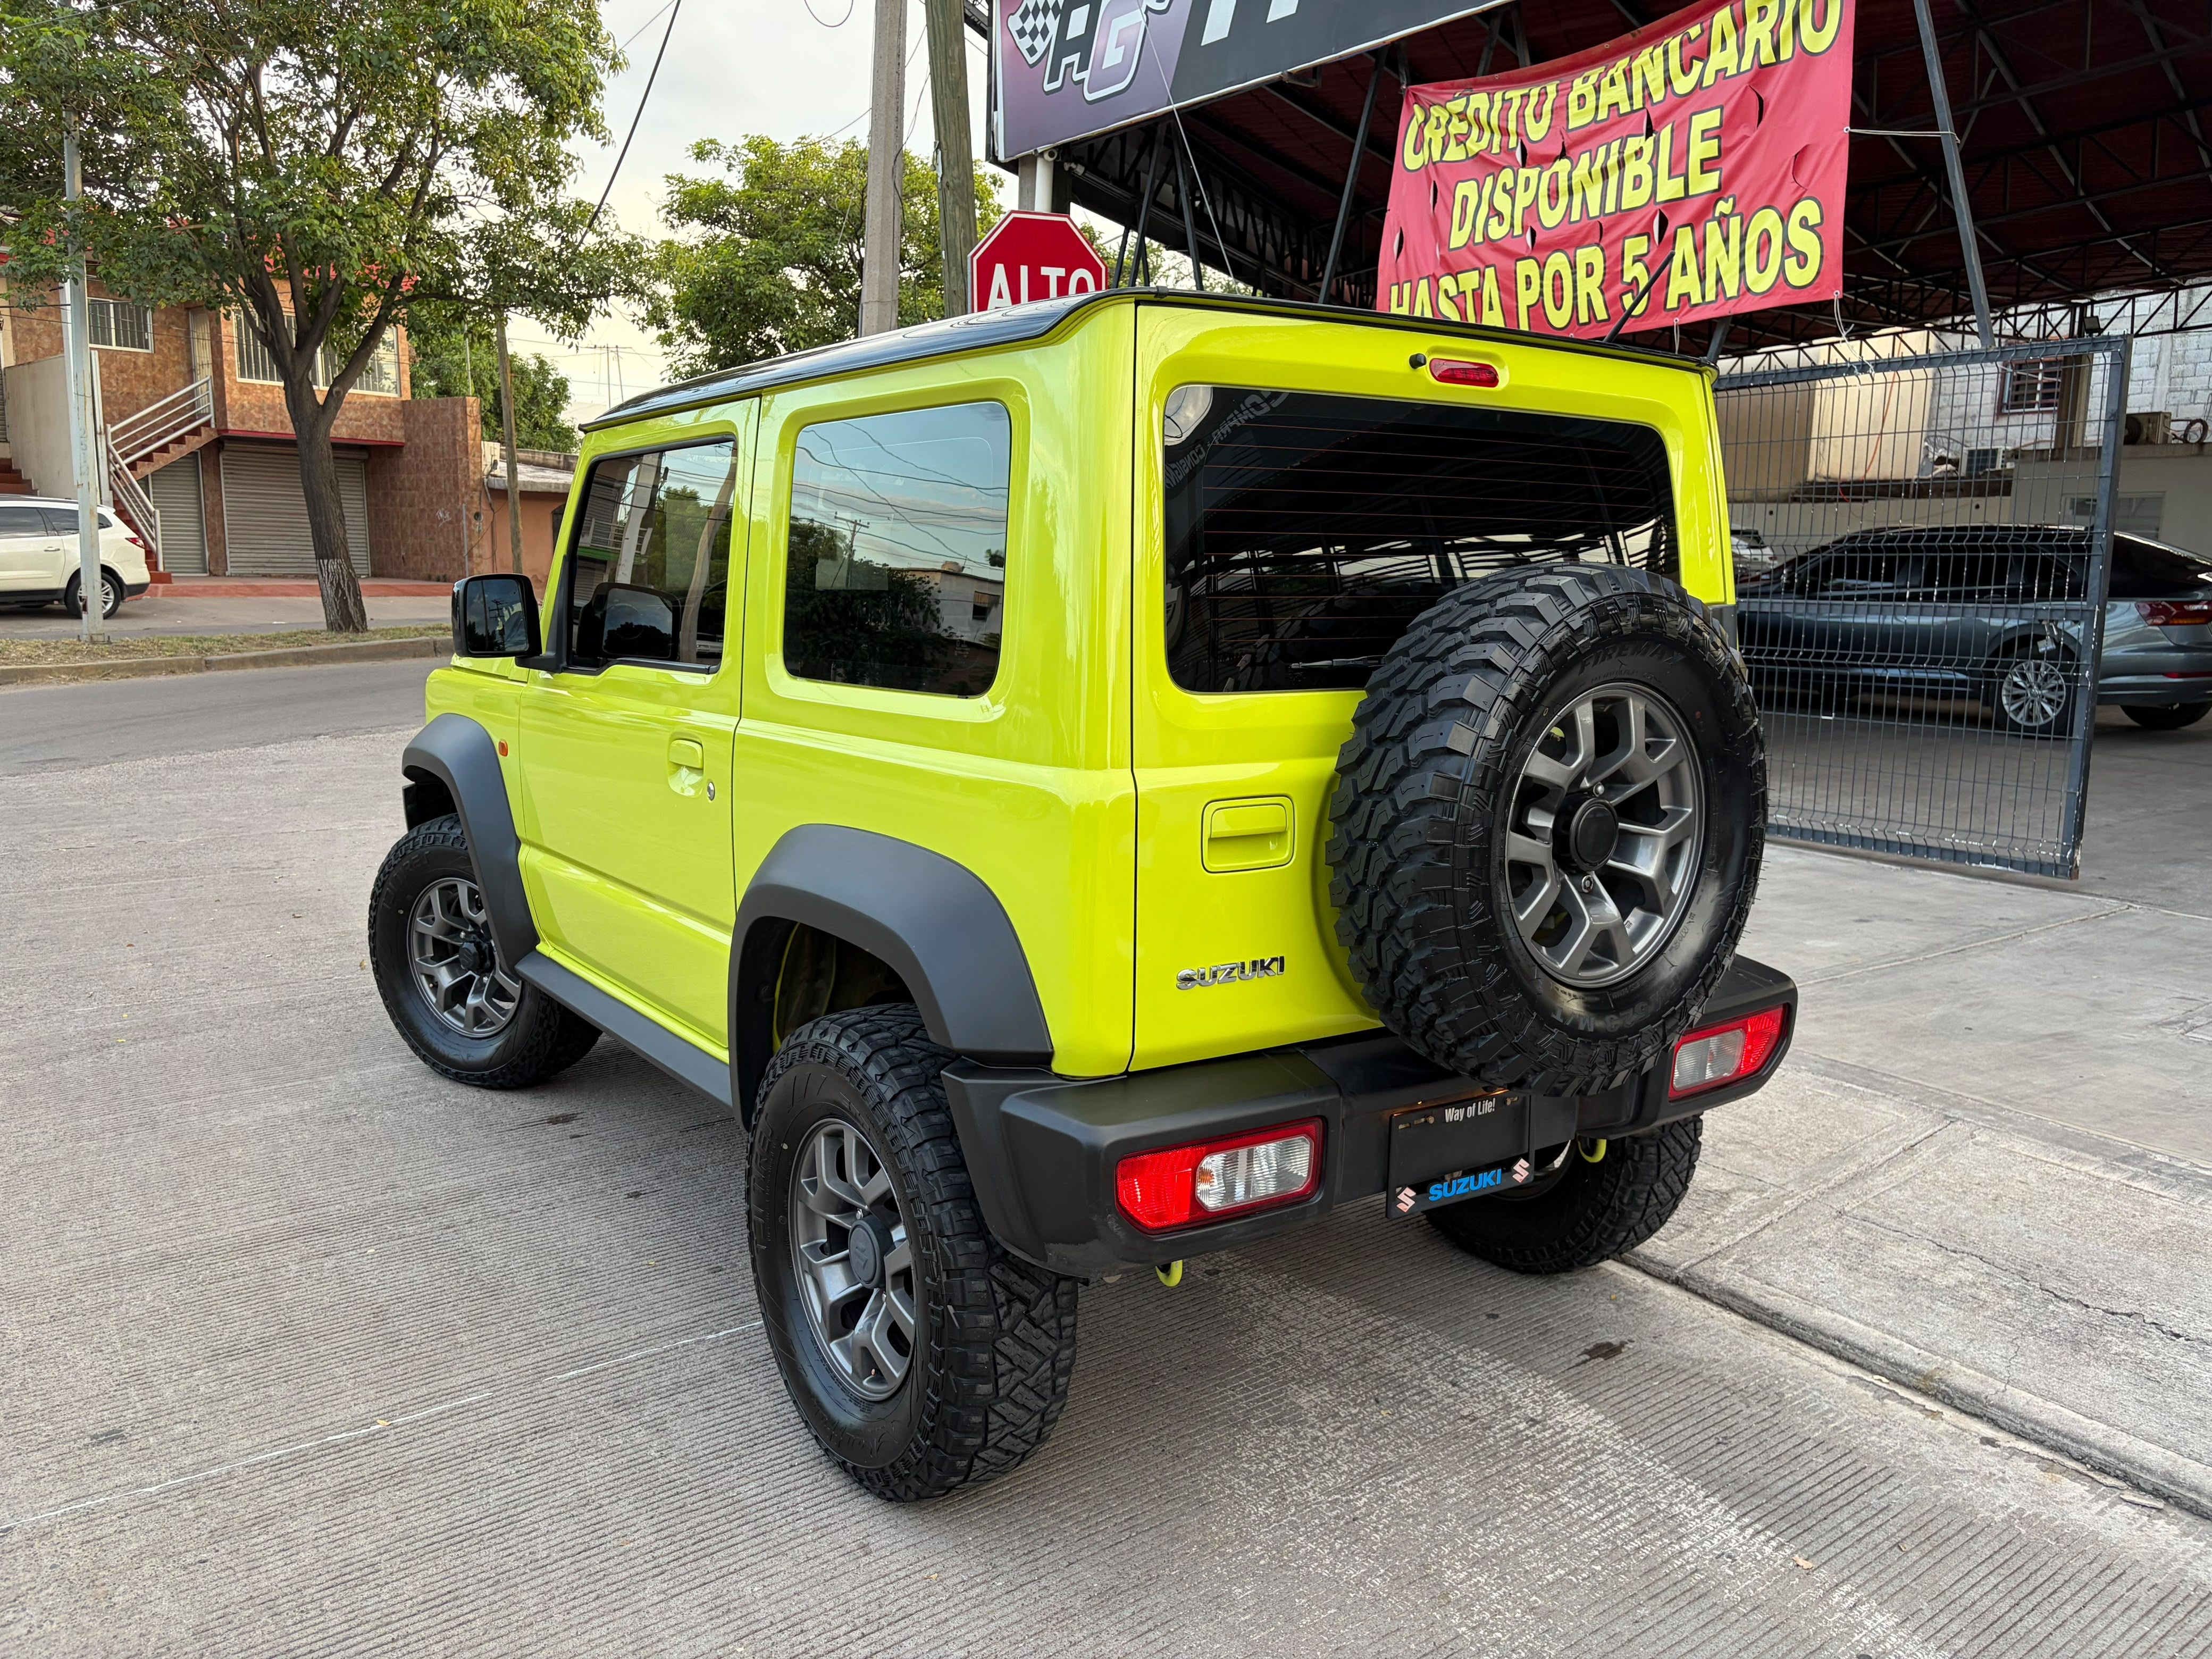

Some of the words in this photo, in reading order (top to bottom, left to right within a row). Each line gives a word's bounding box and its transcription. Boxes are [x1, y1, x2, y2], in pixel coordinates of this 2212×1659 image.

[1567, 0, 1843, 132] BANCARIO
[1448, 106, 1724, 251] DISPONIBLE
[1515, 243, 1610, 331] POR
[1620, 232, 1650, 318] 5
[1663, 194, 1824, 312] AÑOS
[1176, 956, 1285, 990] SUZUKI
[1551, 1008, 1594, 1032] M/T
[1445, 1107, 1464, 1123] Way
[1467, 1104, 1476, 1118] of
[1478, 1097, 1496, 1116] Life!
[1428, 1168, 1502, 1202] SUZUKI
